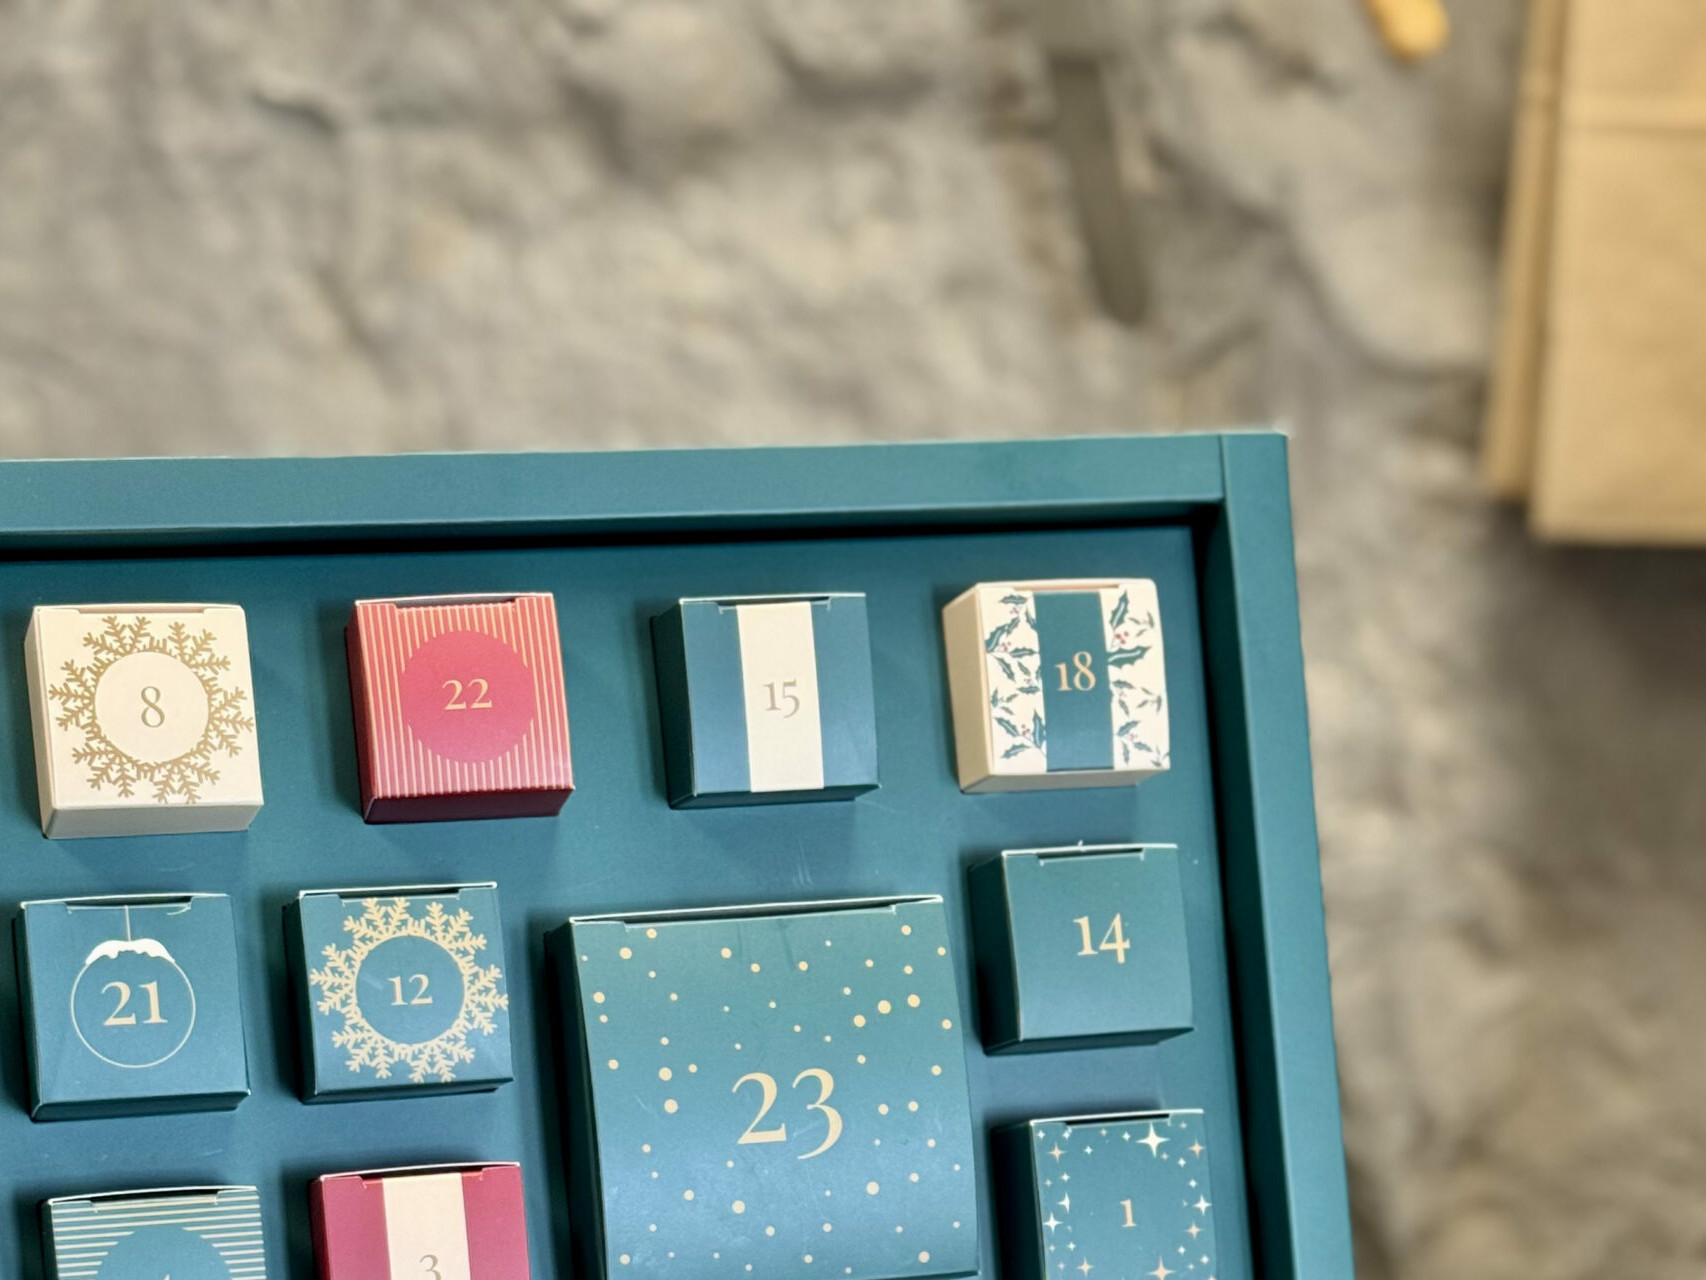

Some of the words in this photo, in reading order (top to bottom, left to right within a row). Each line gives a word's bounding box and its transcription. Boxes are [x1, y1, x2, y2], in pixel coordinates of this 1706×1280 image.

[1055, 651, 1096, 692] 18
[140, 686, 165, 728] 8
[441, 678, 493, 711] 22
[763, 679, 800, 718] 15
[1073, 913, 1131, 964] 14
[101, 980, 168, 1026] 21
[387, 973, 433, 1006] 12
[731, 1067, 844, 1161] 23
[1120, 1199, 1137, 1228] 1
